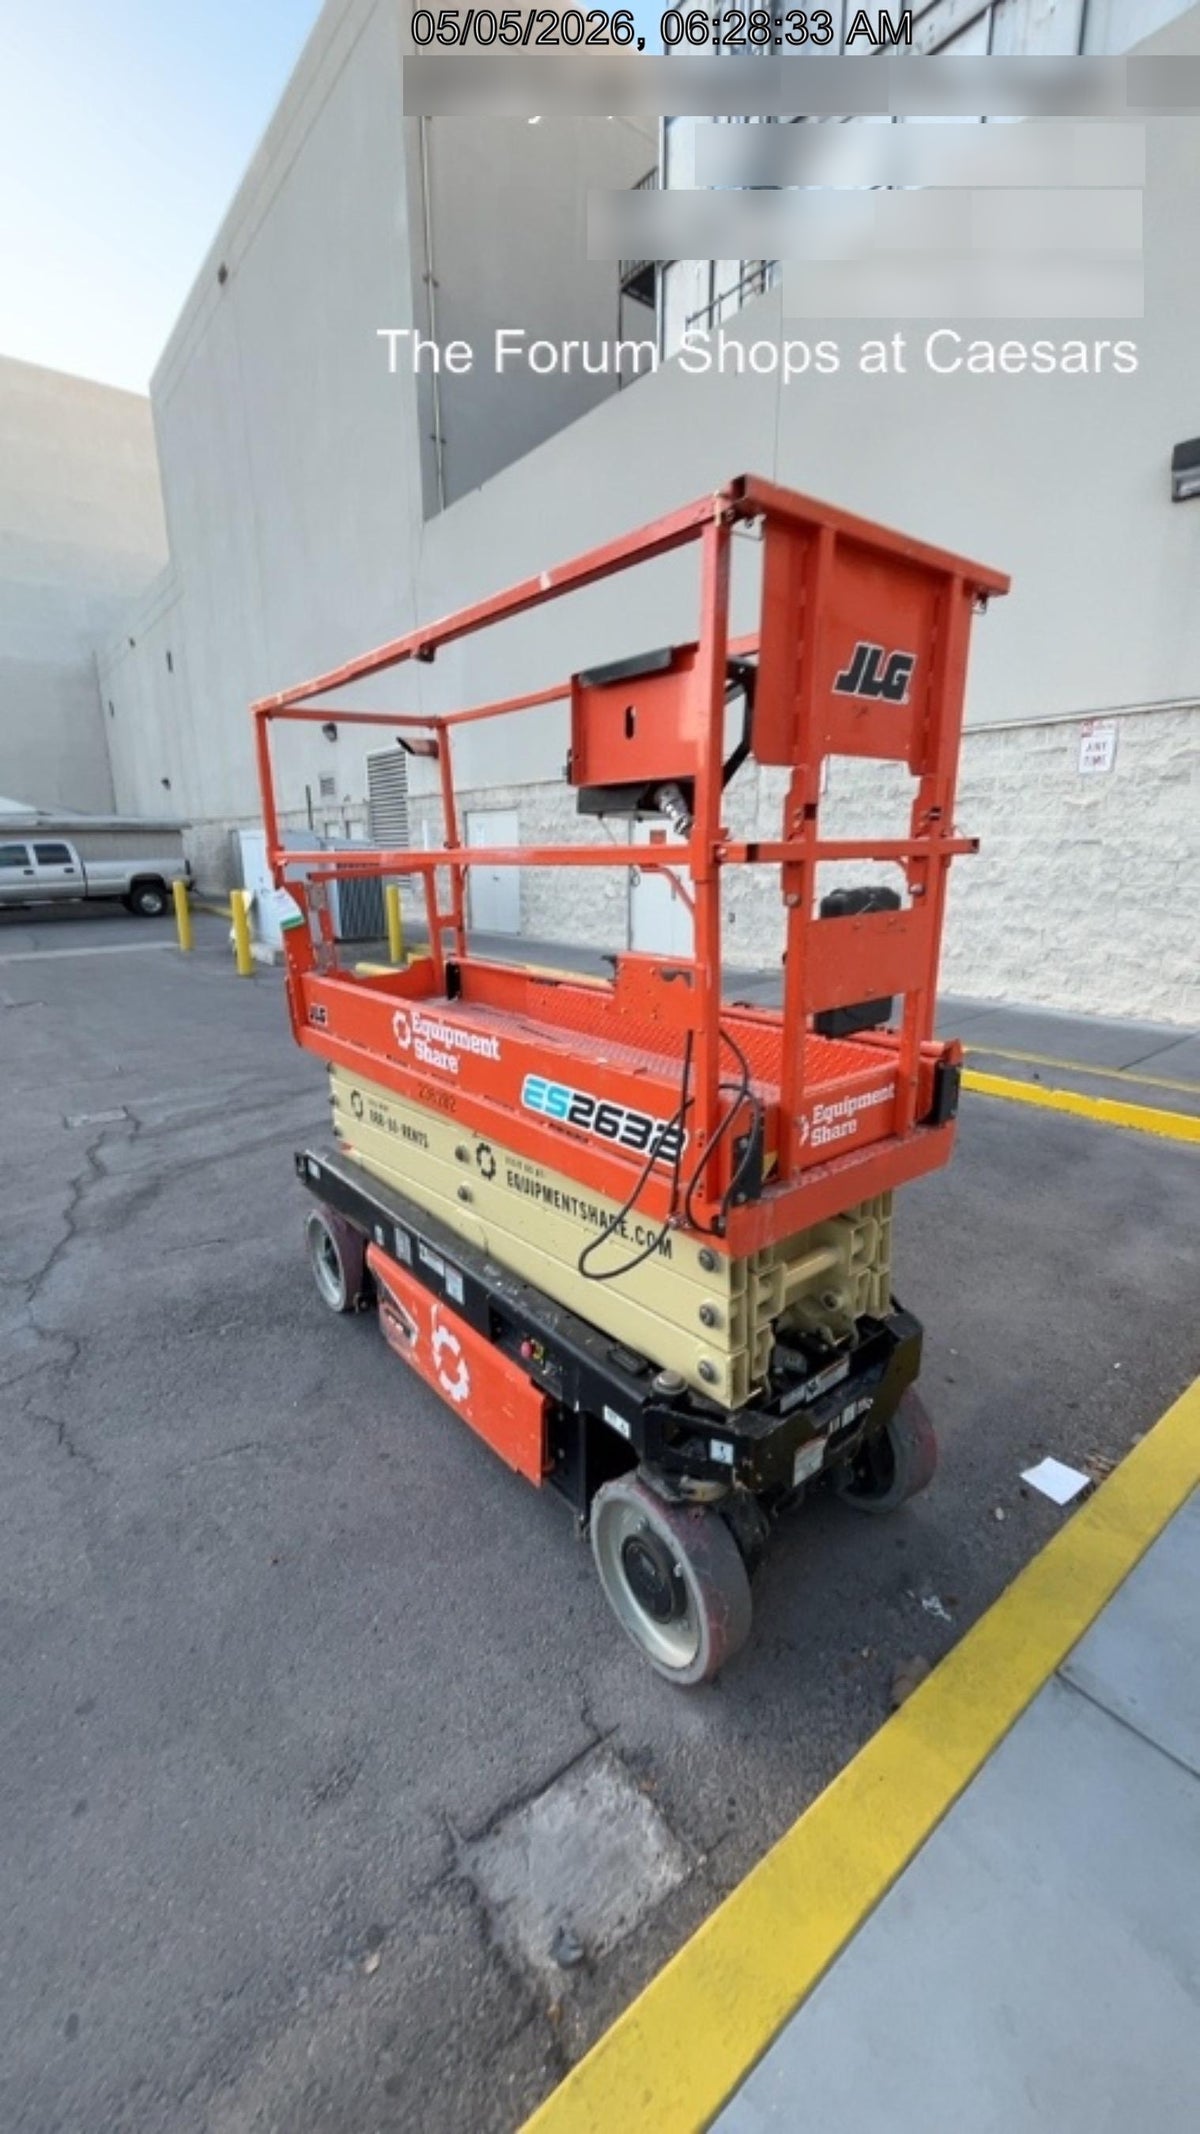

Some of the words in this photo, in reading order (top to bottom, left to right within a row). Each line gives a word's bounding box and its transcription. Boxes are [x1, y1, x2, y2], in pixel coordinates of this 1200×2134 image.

[832, 641, 917, 705] JLG
[411, 1009, 501, 1061] Equipment
[414, 1037, 459, 1074] Share
[522, 1074, 689, 1167] ES2632
[813, 1082, 896, 1125] Equipment
[810, 1119, 858, 1148] Share
